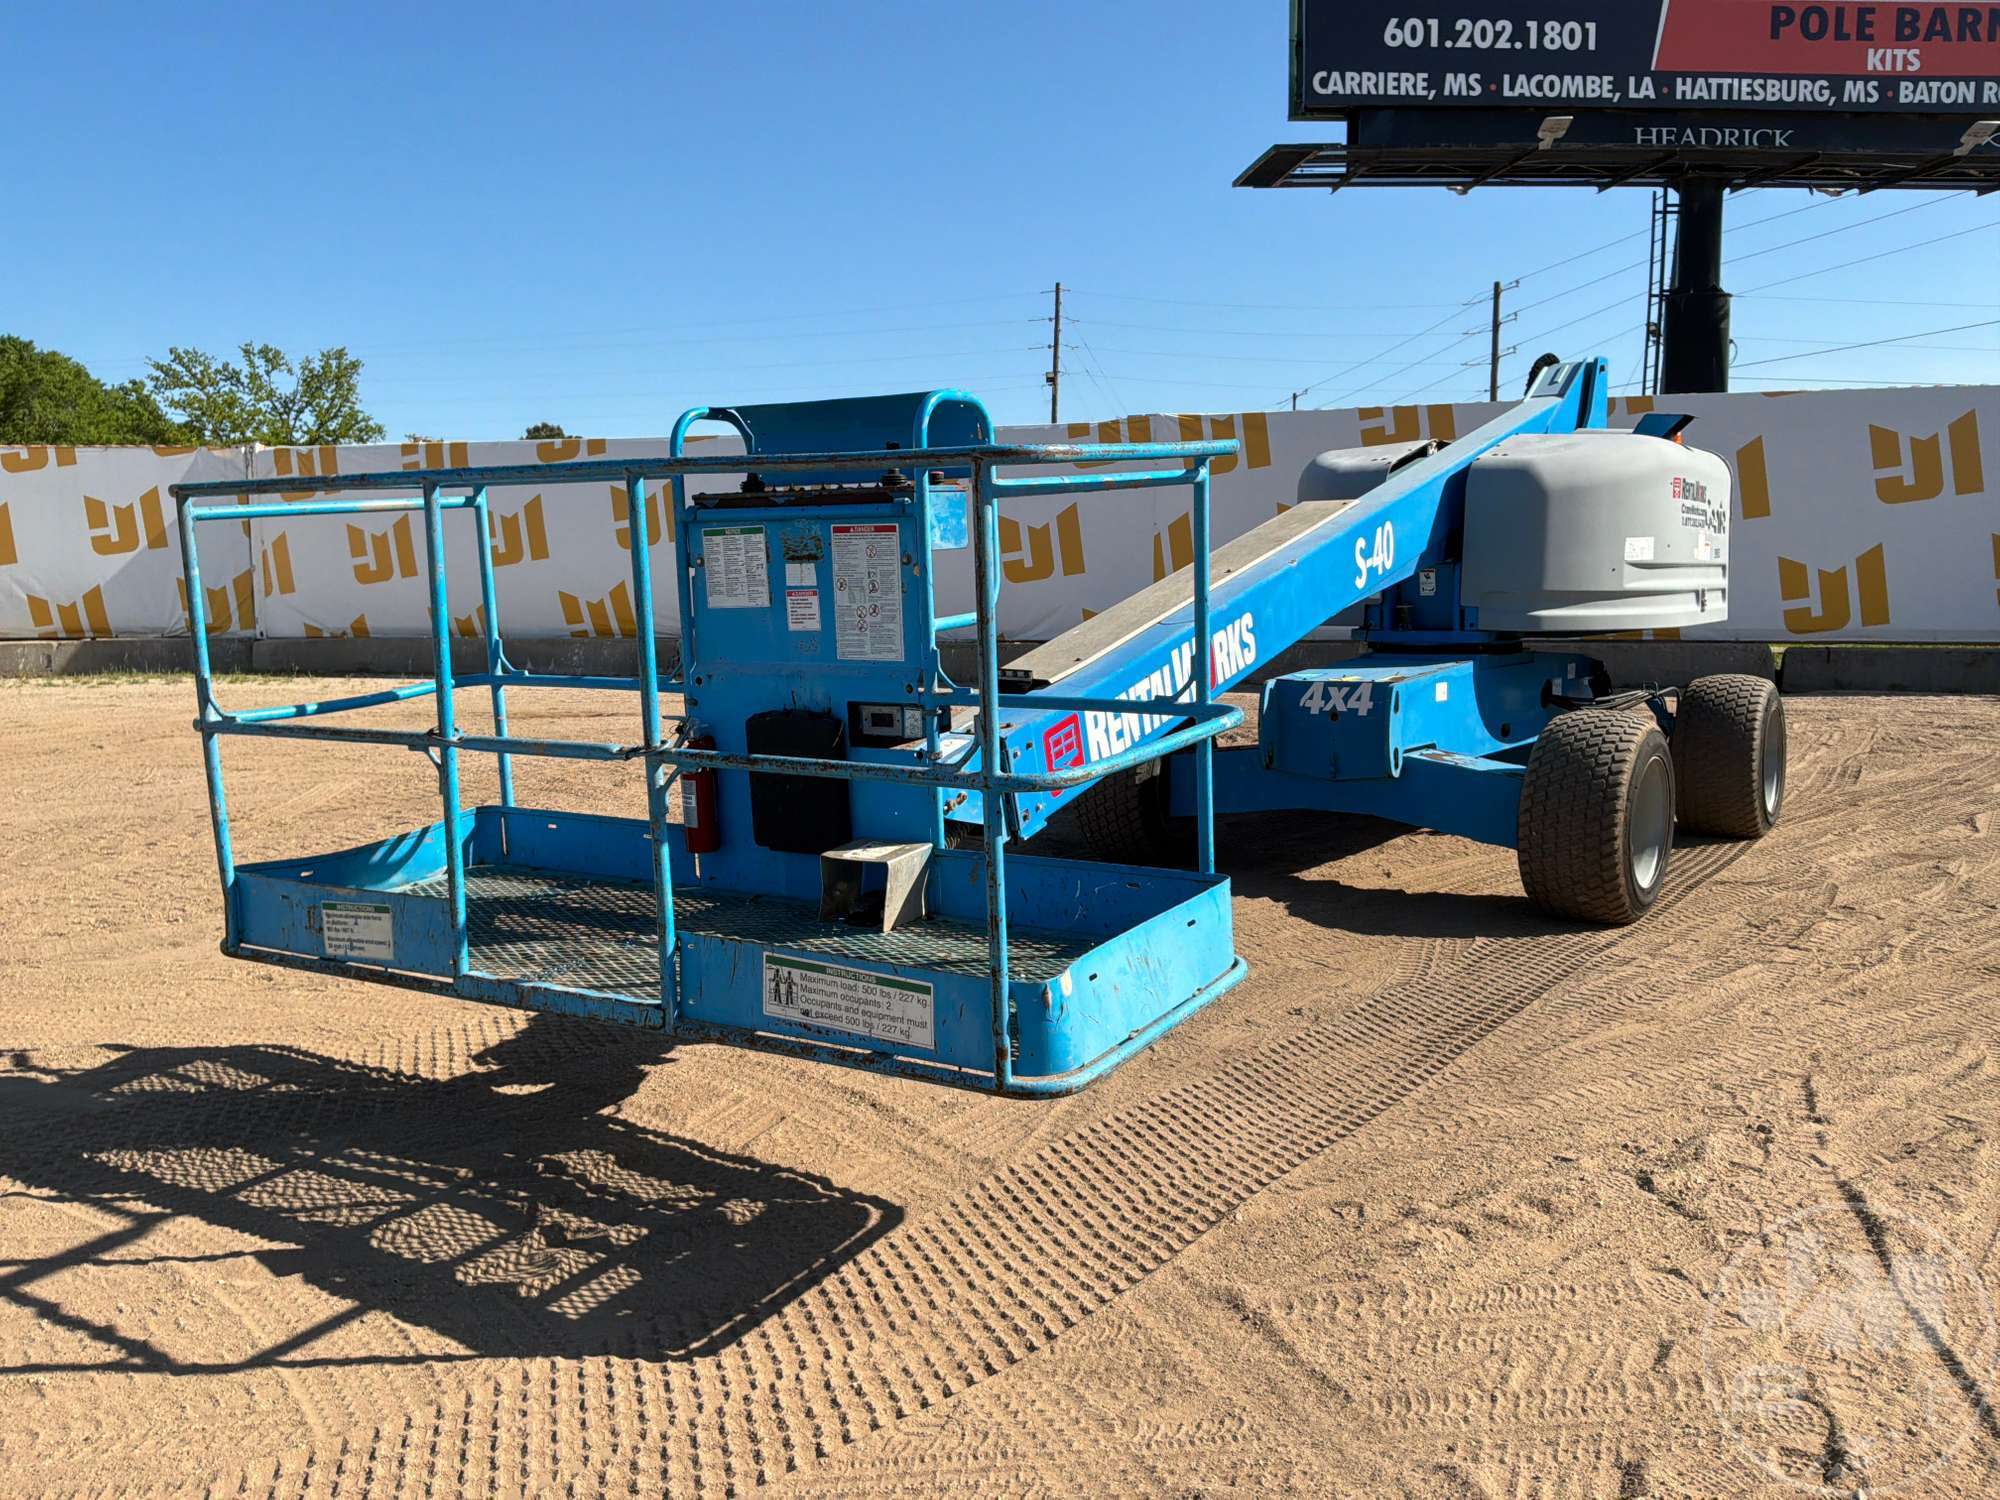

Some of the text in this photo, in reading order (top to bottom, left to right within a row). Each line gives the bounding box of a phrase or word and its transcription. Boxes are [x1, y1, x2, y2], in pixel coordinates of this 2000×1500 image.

[1383, 17, 1597, 51] 601.202.1801
[1769, 5, 1876, 42] POLE
[1866, 48, 1921, 71] KITS
[1312, 70, 2000, 107] CARRIERE, MS LACOMBE, LA HATTIESBURG, MS BATON R
[1633, 127, 1795, 148] HEADRICK
[1354, 519, 1395, 589] S-40
[1299, 681, 1374, 716] 4x4
[800, 973, 839, 989] Maximum
[840, 981, 860, 994] load:
[861, 986, 878, 997] 500
[880, 988, 892, 1000] lbs
[899, 993, 915, 1004] 227
[826, 967, 878, 985] INSTRUCTIONS
[800, 984, 839, 1000] Maximum
[840, 993, 884, 1010] occupants:
[800, 996, 927, 1029] Occupants and equipment must
[815, 1010, 844, 1025] exceed
[845, 1015, 860, 1027] 500
[862, 1019, 874, 1030] lbs
[881, 1023, 897, 1034] 227
